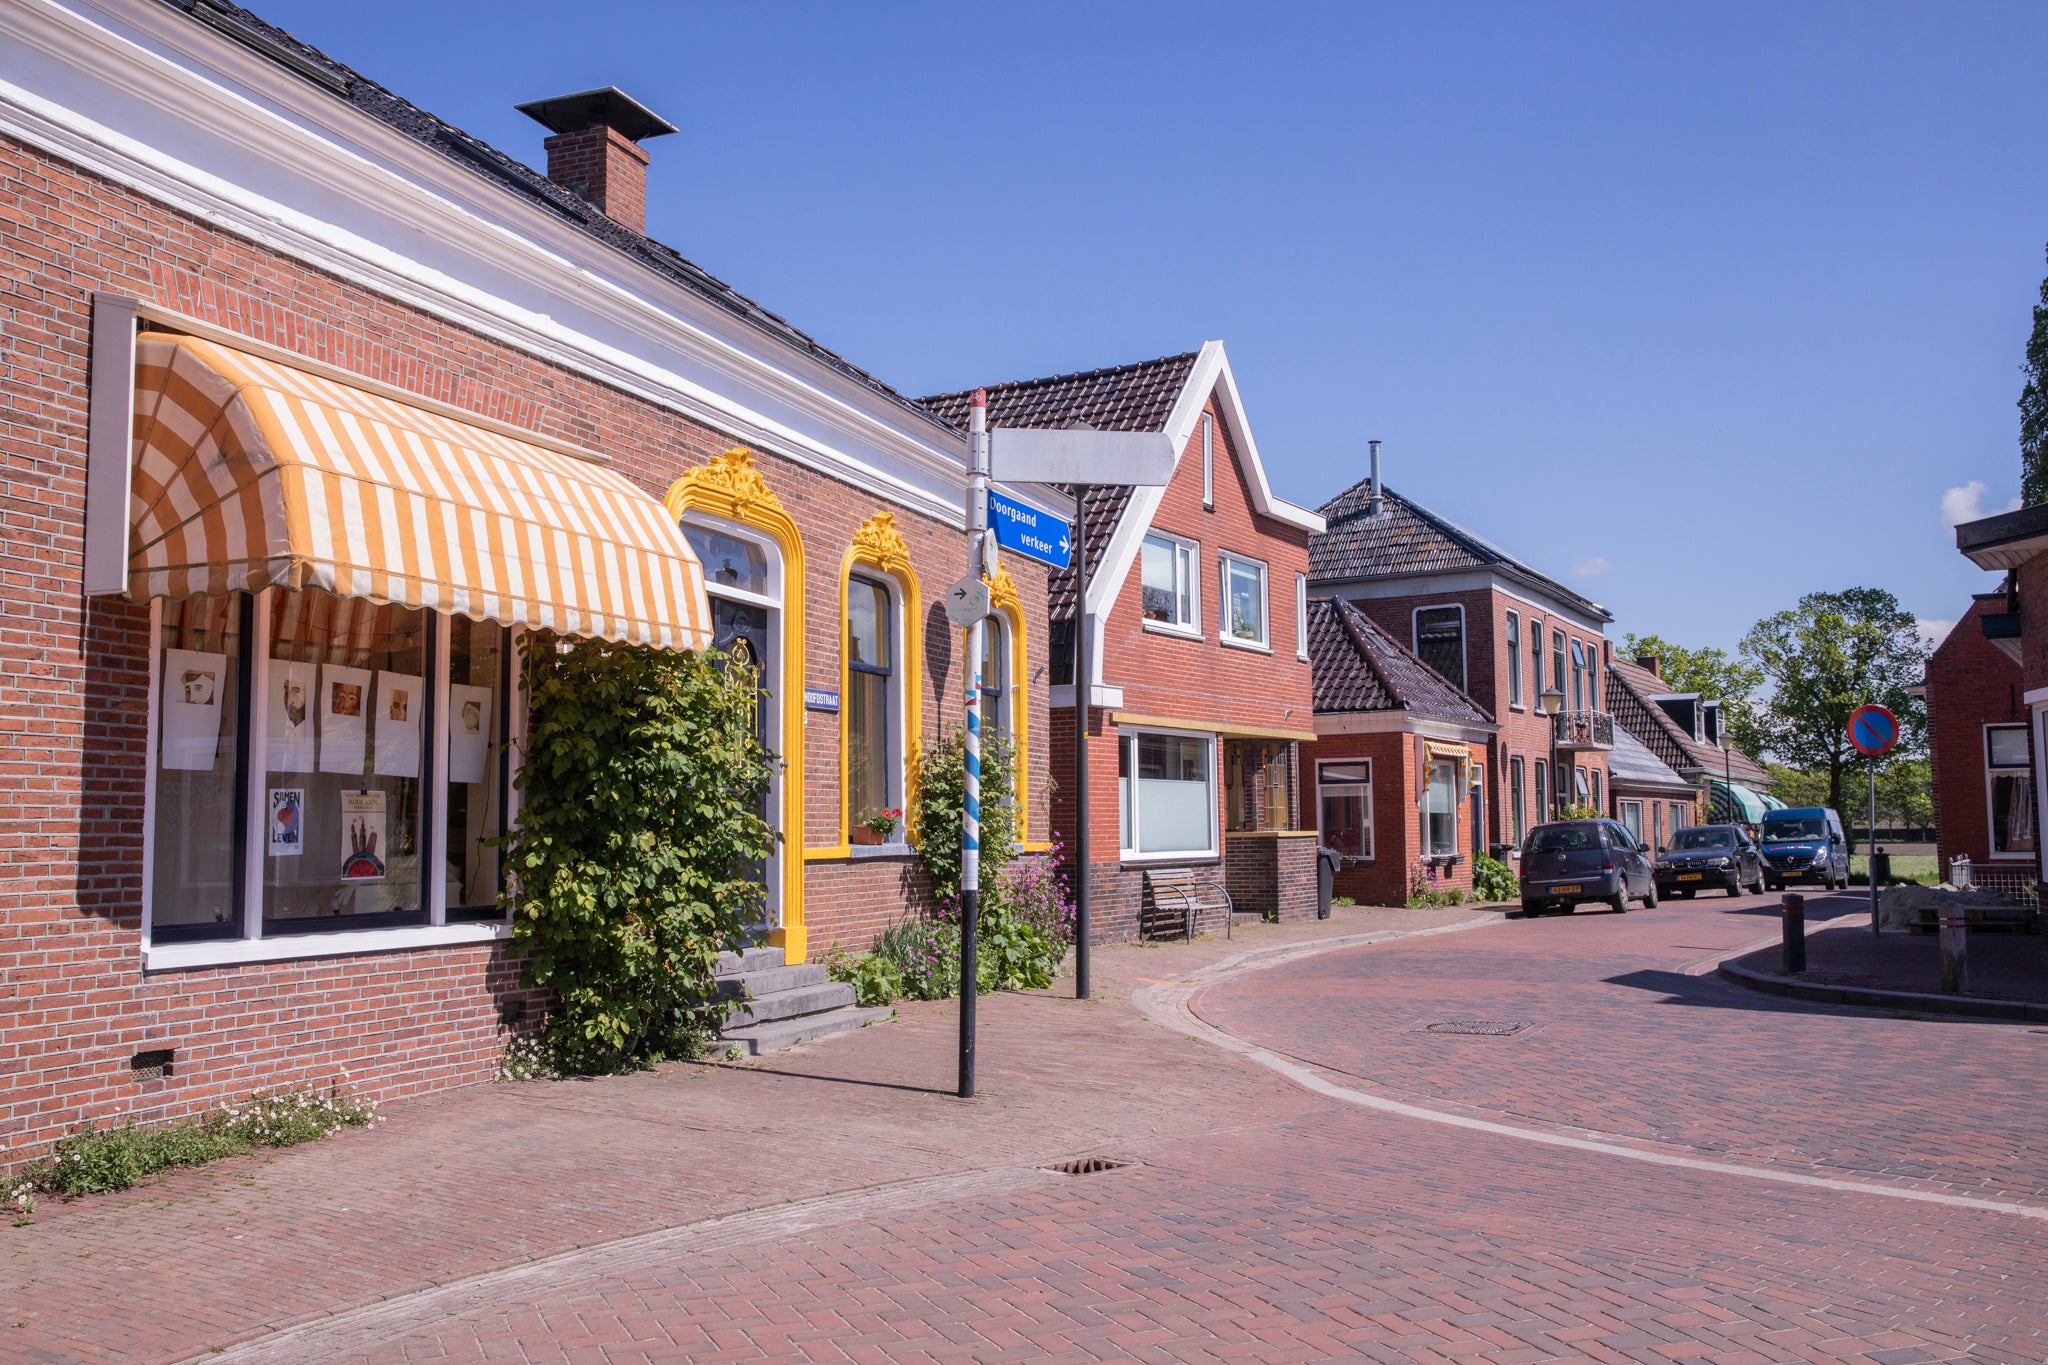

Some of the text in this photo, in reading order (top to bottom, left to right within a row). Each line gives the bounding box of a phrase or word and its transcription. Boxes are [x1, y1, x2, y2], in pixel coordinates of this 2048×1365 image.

[990, 497, 1037, 528] Doorgaand
[1020, 533, 1053, 555] verkeer
[273, 791, 301, 809] SAMEN
[272, 827, 299, 843] LEVEN
